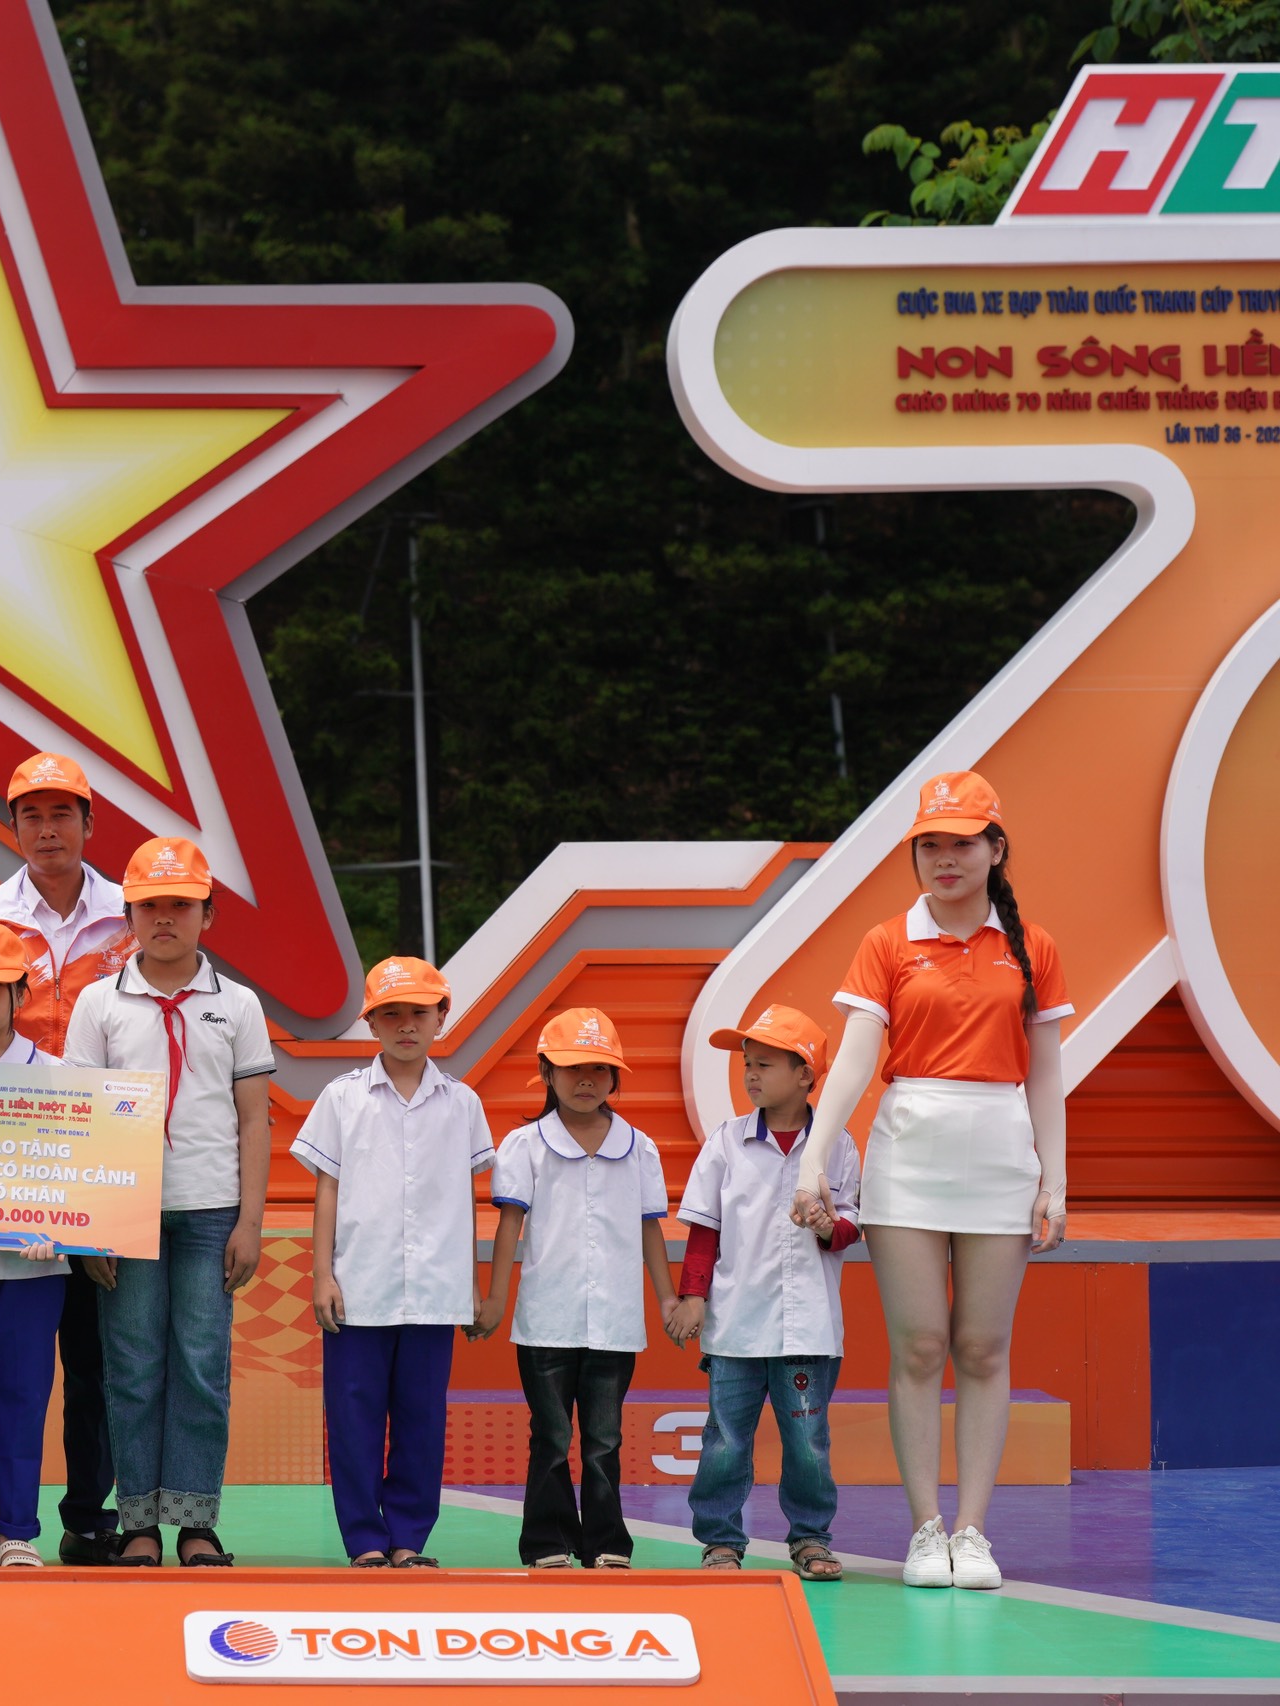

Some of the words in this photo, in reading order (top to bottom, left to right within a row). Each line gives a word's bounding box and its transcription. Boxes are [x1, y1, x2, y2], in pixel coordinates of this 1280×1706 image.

[897, 287, 939, 319] CUỘC
[943, 291, 977, 314] ĐUA
[982, 290, 1004, 314] XE
[1008, 290, 1042, 319] ĐẠP
[1046, 286, 1089, 314] TOÀN
[1094, 284, 1137, 314] QUỐC
[1141, 290, 1196, 314] TRANH
[1201, 286, 1233, 313] CÚP
[1237, 289, 1280, 313] TRUY
[897, 345, 1013, 380] NON
[1036, 335, 1182, 384] SÔNG
[895, 390, 948, 413] CHÀO
[952, 388, 1011, 412] MỪNG
[1016, 392, 1042, 412] 70
[1046, 388, 1092, 412] NĂM
[1097, 386, 1151, 412] CHIẾN
[1155, 384, 1220, 411] THẮNG
[1225, 387, 1268, 413] ĐIỆN
[1224, 426, 1241, 443] 36
[9, 1097, 34, 1110] LIỀN
[38, 1101, 66, 1113] MỘT
[20, 1139, 71, 1160] TẶNG
[22, 1164, 77, 1182] HOÀN
[82, 1165, 136, 1185] CẢNH
[10, 1184, 65, 1204] KHĂN
[49, 1211, 91, 1227] VNĐ
[291, 1628, 421, 1656] TON
[435, 1628, 612, 1656] DONG
[625, 1629, 672, 1656] A
